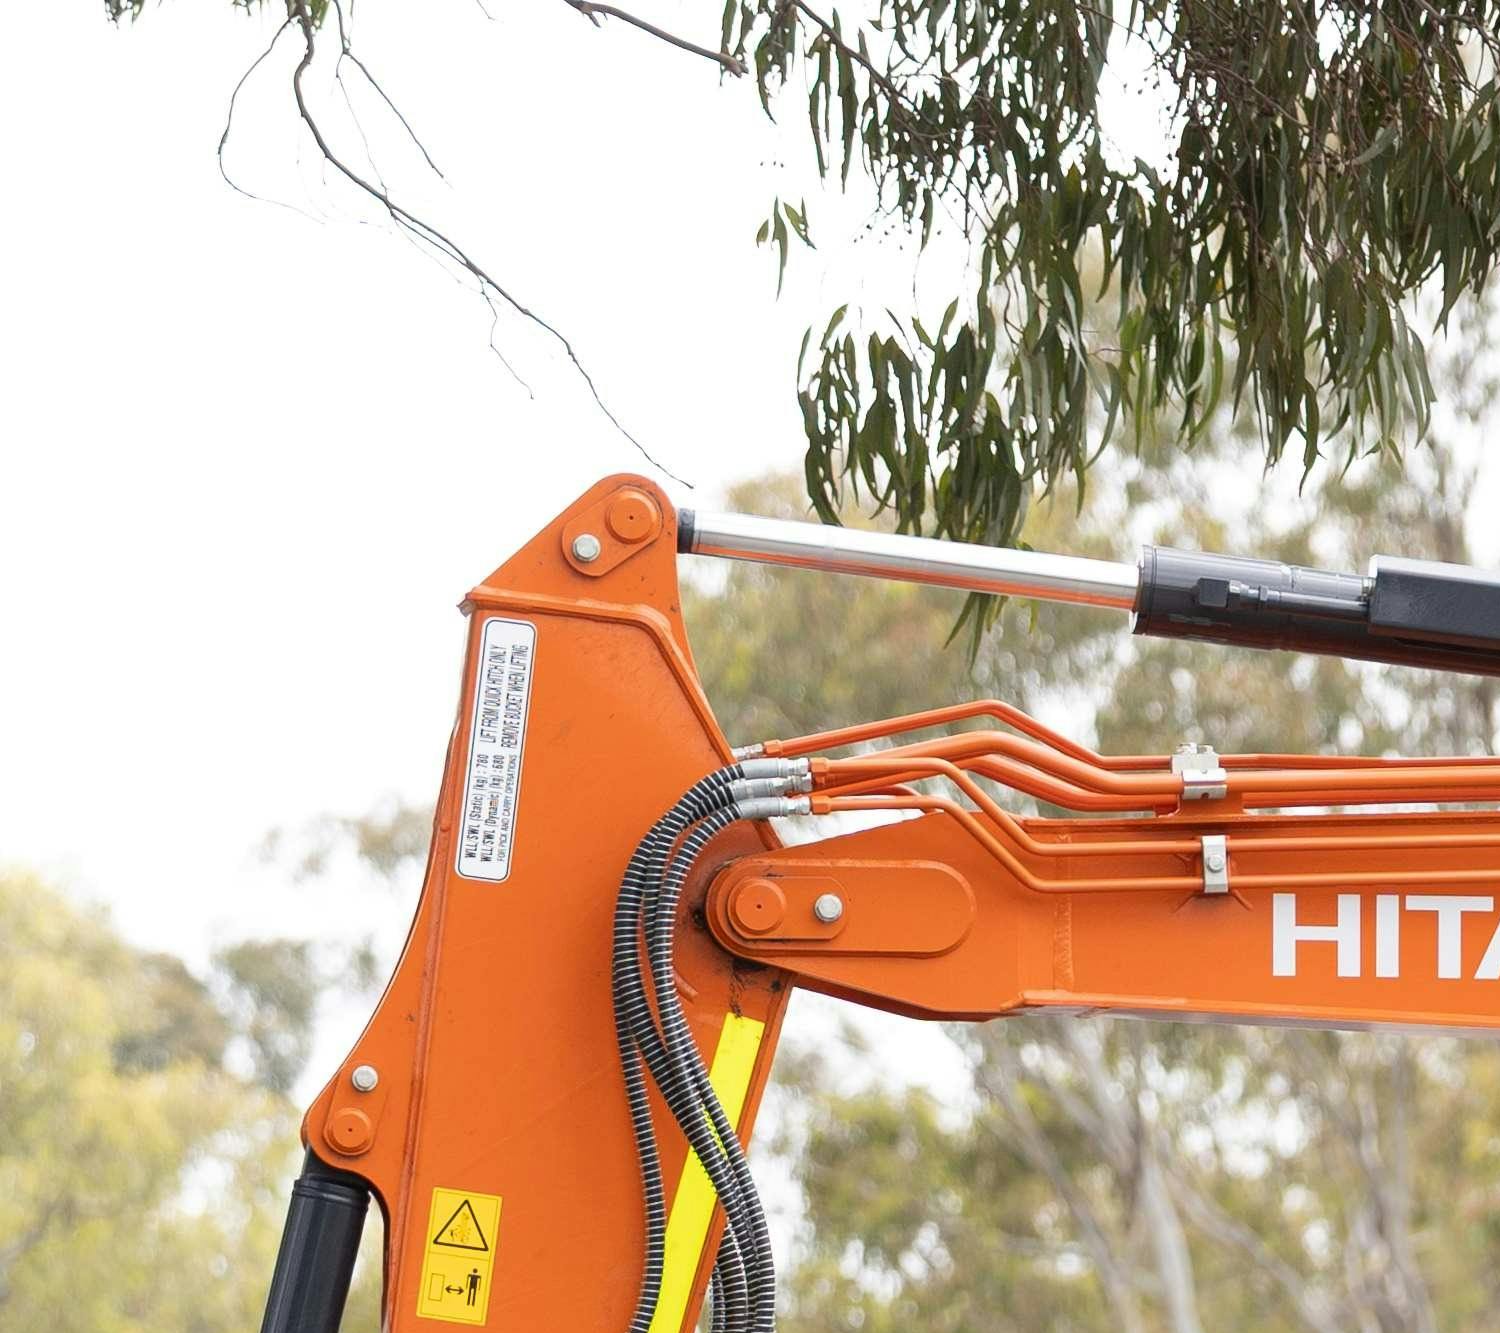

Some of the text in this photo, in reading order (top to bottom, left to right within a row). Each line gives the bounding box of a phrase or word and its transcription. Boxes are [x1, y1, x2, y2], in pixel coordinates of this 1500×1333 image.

[480, 644, 507, 743] LIFT FROM QUICK HITCH ONLY
[501, 644, 529, 748] REMOVE BUCKET WHEN LIFTING
[476, 754, 489, 768] 780
[505, 754, 518, 794] OPERATIONS
[468, 793, 486, 821] (Static)
